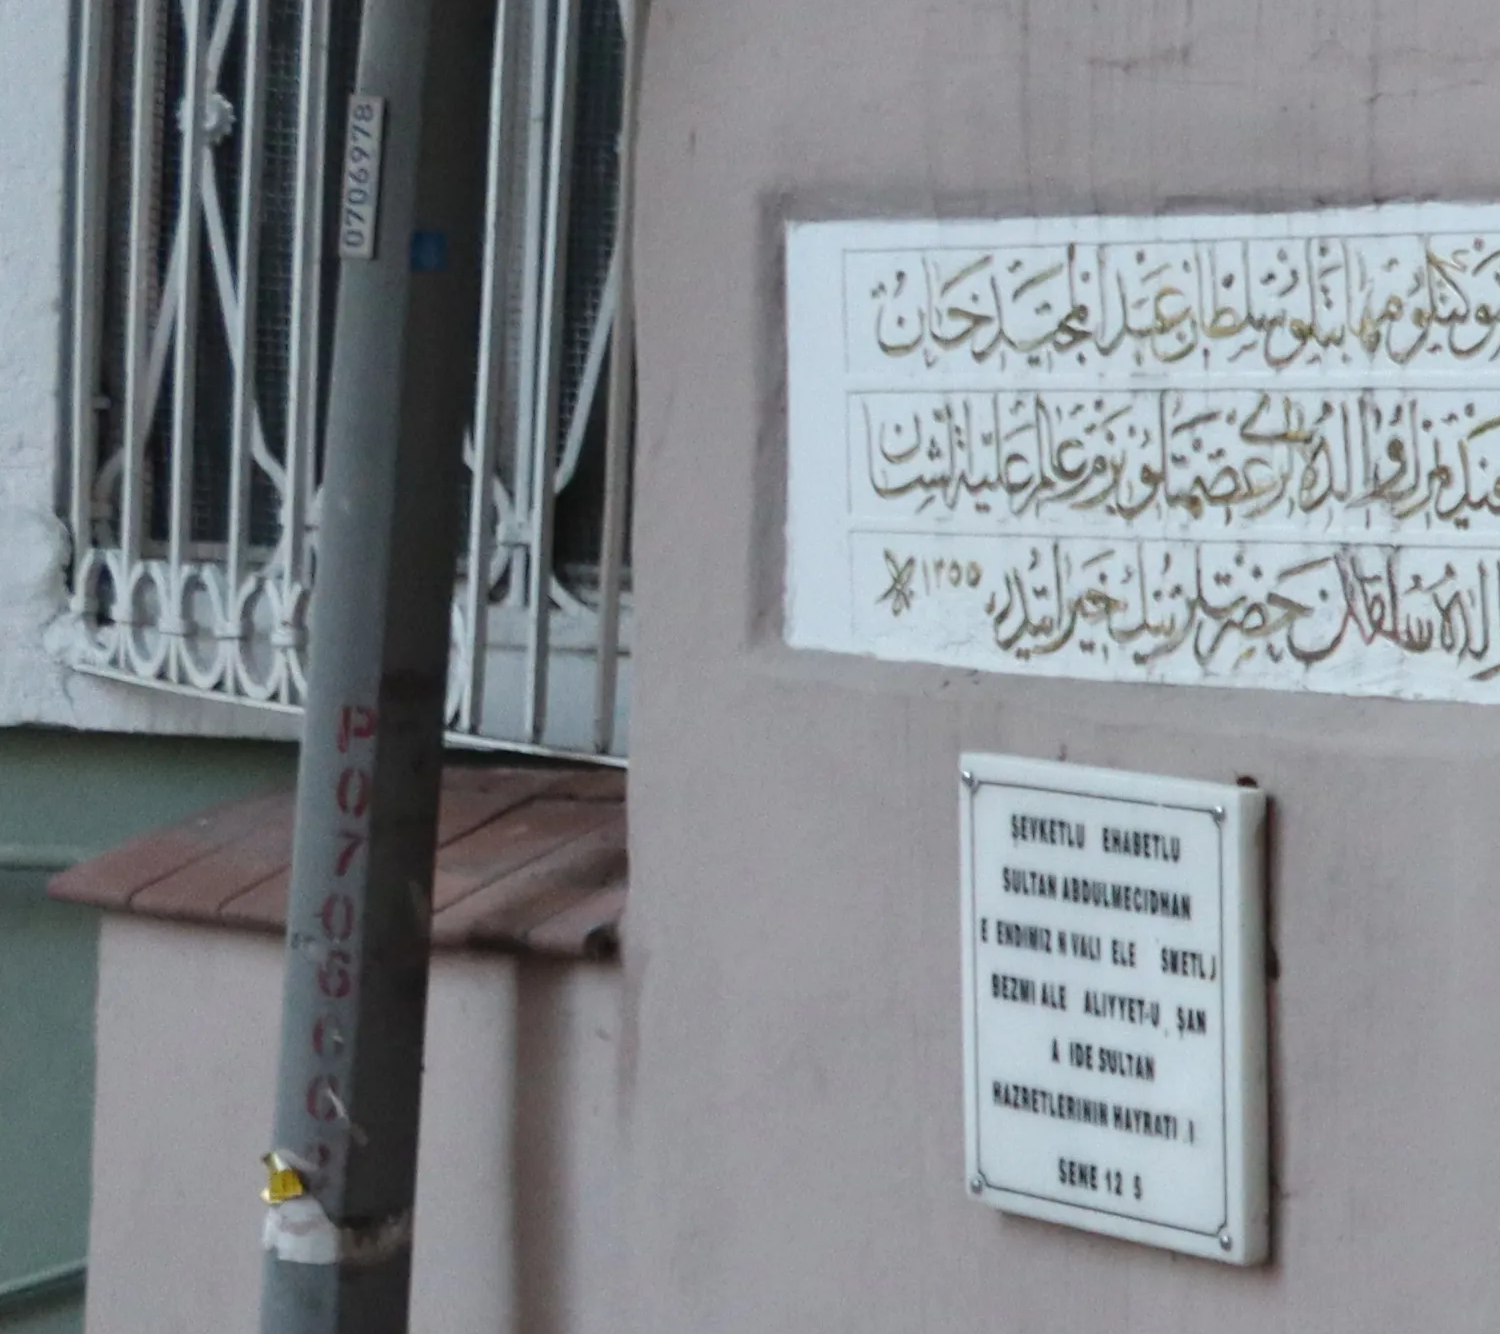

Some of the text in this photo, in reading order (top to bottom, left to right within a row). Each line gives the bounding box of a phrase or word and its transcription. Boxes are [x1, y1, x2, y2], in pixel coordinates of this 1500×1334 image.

[343, 102, 376, 248] 0706978
[1001, 865, 1057, 899] SULTAN
[990, 972, 1036, 1005] BEZMI
[1097, 1046, 1155, 1082] SULTAN
[992, 1079, 1108, 1127] HAZRETLERININ
[1057, 1155, 1098, 1190] SENE
